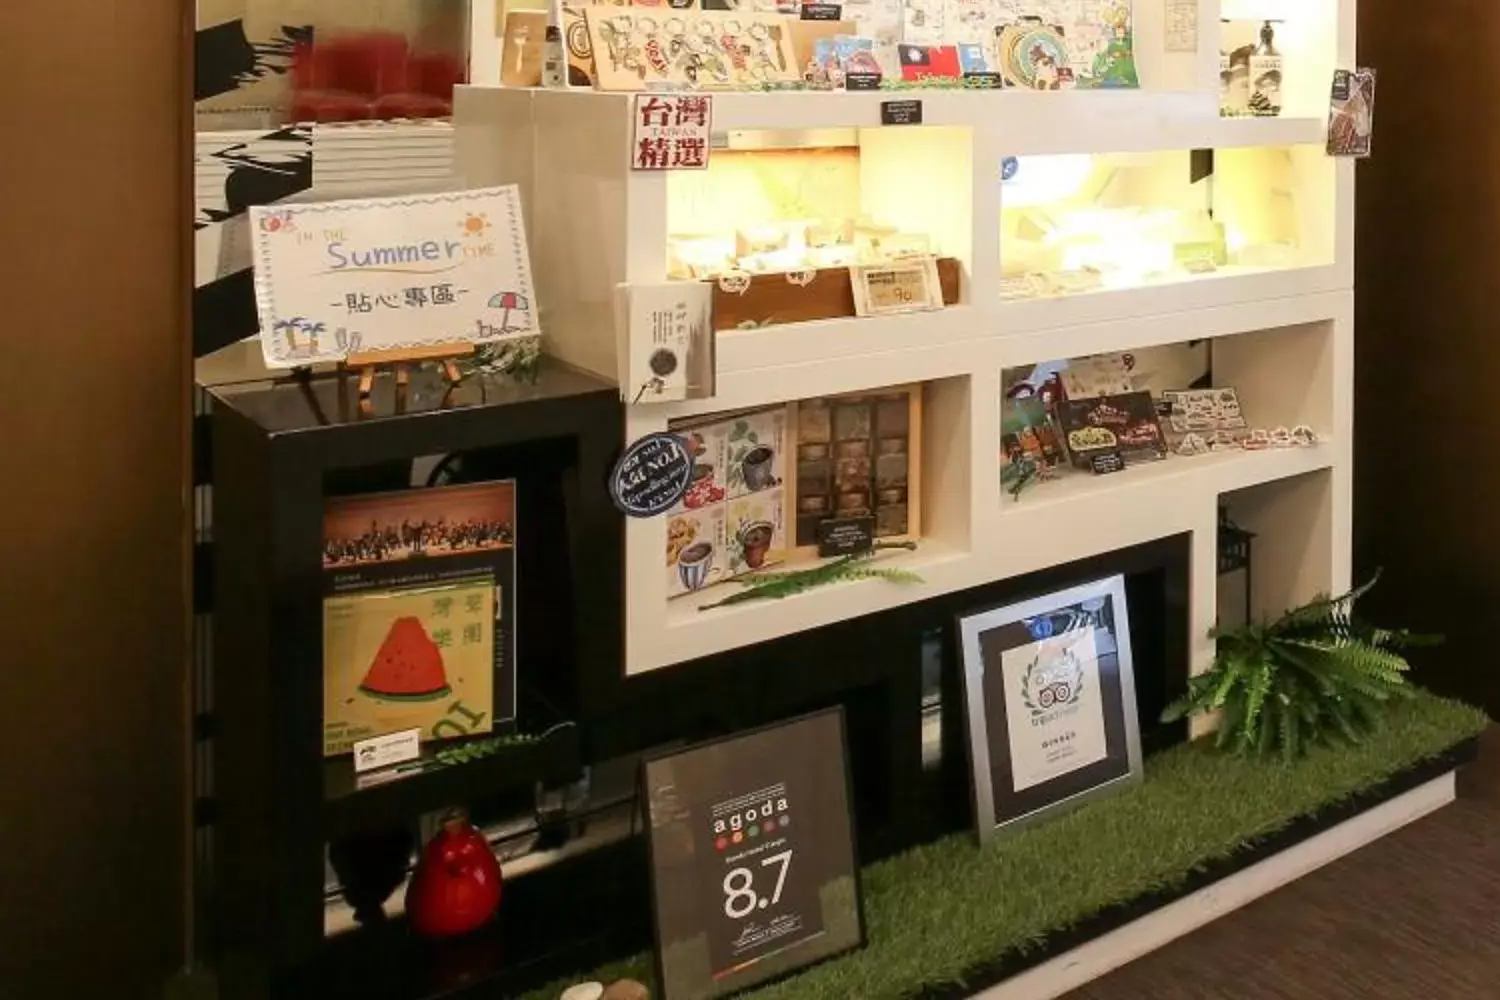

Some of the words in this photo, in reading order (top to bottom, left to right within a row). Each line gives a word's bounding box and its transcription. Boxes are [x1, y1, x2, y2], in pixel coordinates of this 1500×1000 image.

[640, 96, 706, 127] 台灣
[639, 137, 705, 167] 精選
[327, 239, 461, 269] Summer
[713, 798, 789, 834] agoda
[722, 849, 794, 919] 8.7
